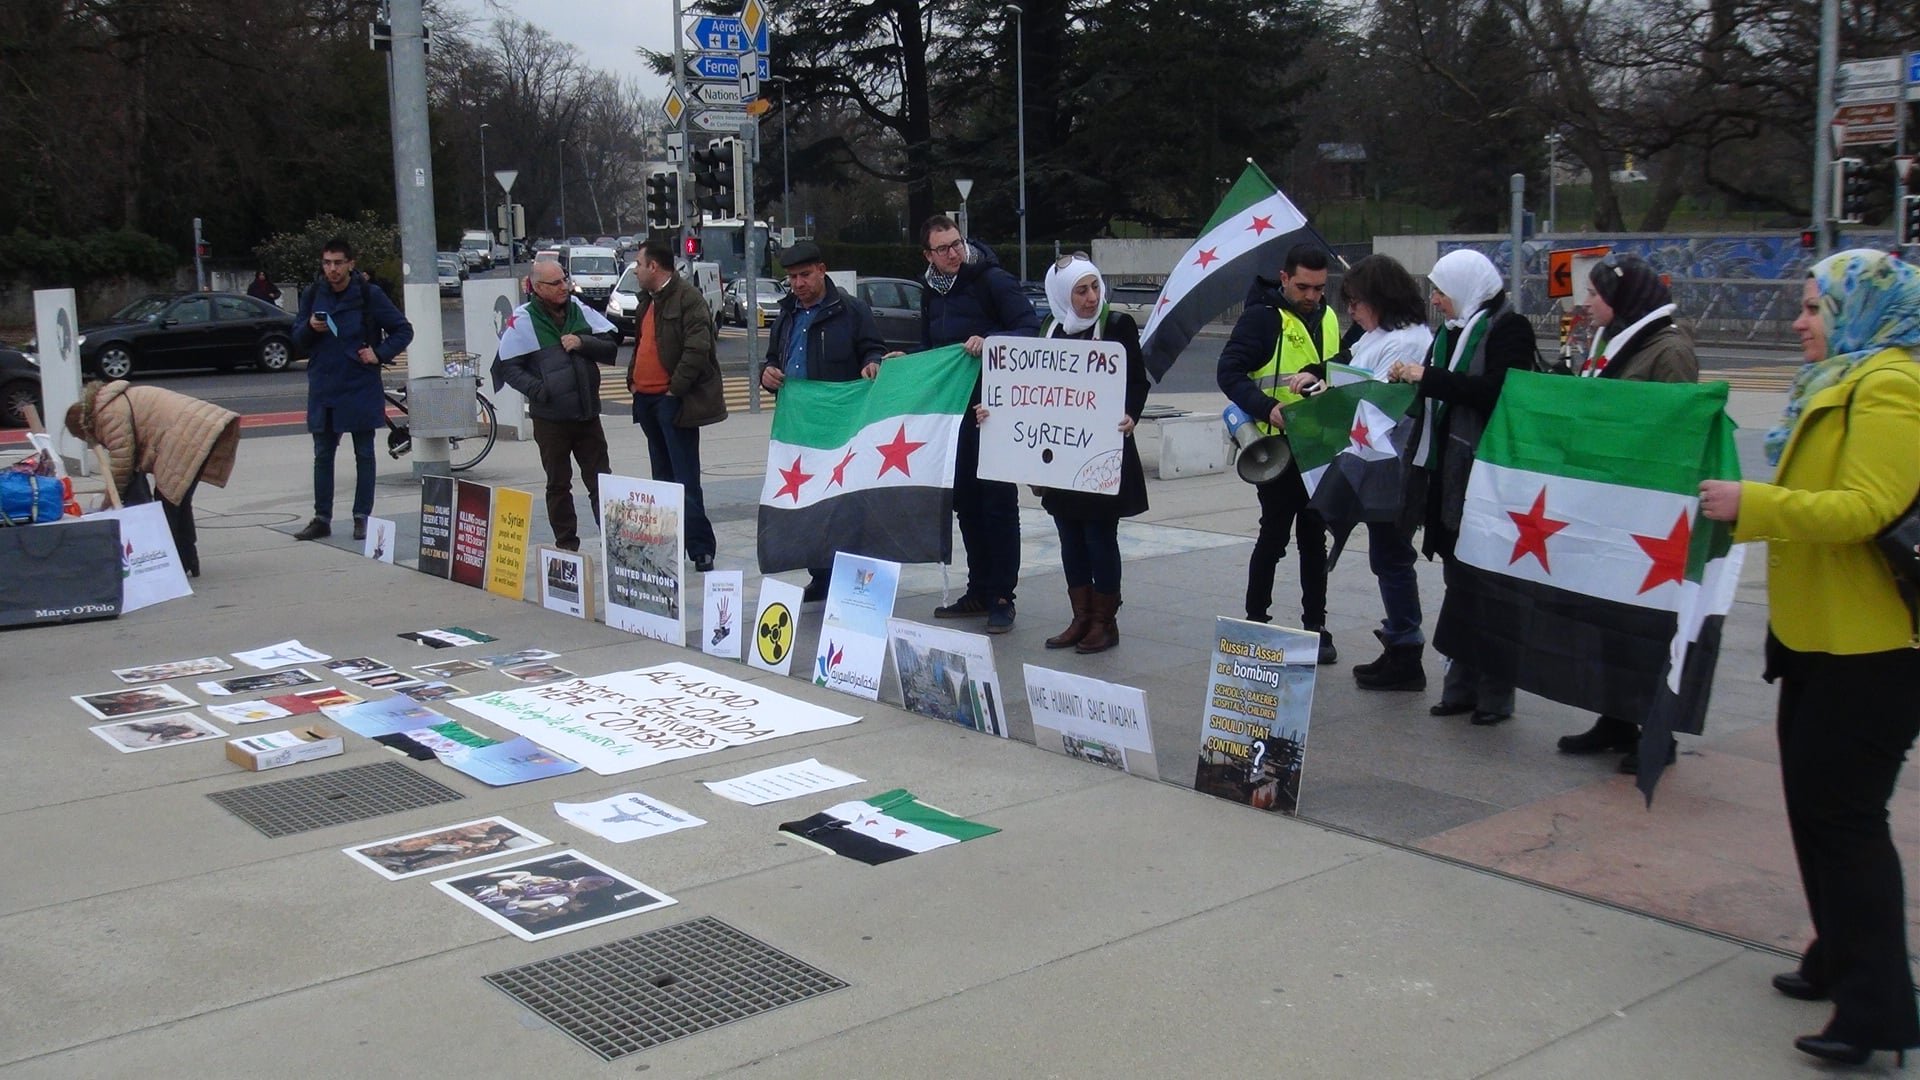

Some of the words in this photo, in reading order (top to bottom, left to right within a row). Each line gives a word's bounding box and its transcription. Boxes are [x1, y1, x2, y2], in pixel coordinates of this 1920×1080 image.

[704, 85, 739, 100] Nations
[989, 345, 1007, 371] NE
[1009, 347, 1080, 373] SOUTENEZ
[1087, 350, 1119, 374] PAS
[988, 385, 1003, 407] LE
[1011, 385, 1096, 410] DICTATEUR
[629, 491, 656, 505] SYRIA
[508, 512, 525, 528] Syrian
[615, 566, 640, 580] UNITED
[642, 573, 675, 588] NATIONS
[616, 584, 629, 597] Why
[629, 588, 638, 597] do
[639, 591, 651, 601] you
[35, 608, 70, 618] Marc
[73, 604, 115, 614] O'Polo
[1220, 638, 1249, 657] Russia
[1255, 645, 1283, 663] Assad
[1217, 663, 1231, 675] are
[1233, 661, 1279, 688] bombing
[1214, 684, 1246, 701] SCHOOLS,
[1247, 691, 1278, 707] BAKERIES
[1087, 698, 1107, 723] SAVE
[1212, 697, 1246, 714] HOSPITALS,
[1247, 705, 1276, 720] CHILDREN
[584, 711, 693, 751] COMBAT
[1210, 715, 1244, 734] SHOULD
[1247, 723, 1270, 740] THAT
[1207, 736, 1249, 758] CONTINUE
[1253, 741, 1265, 774] ?
